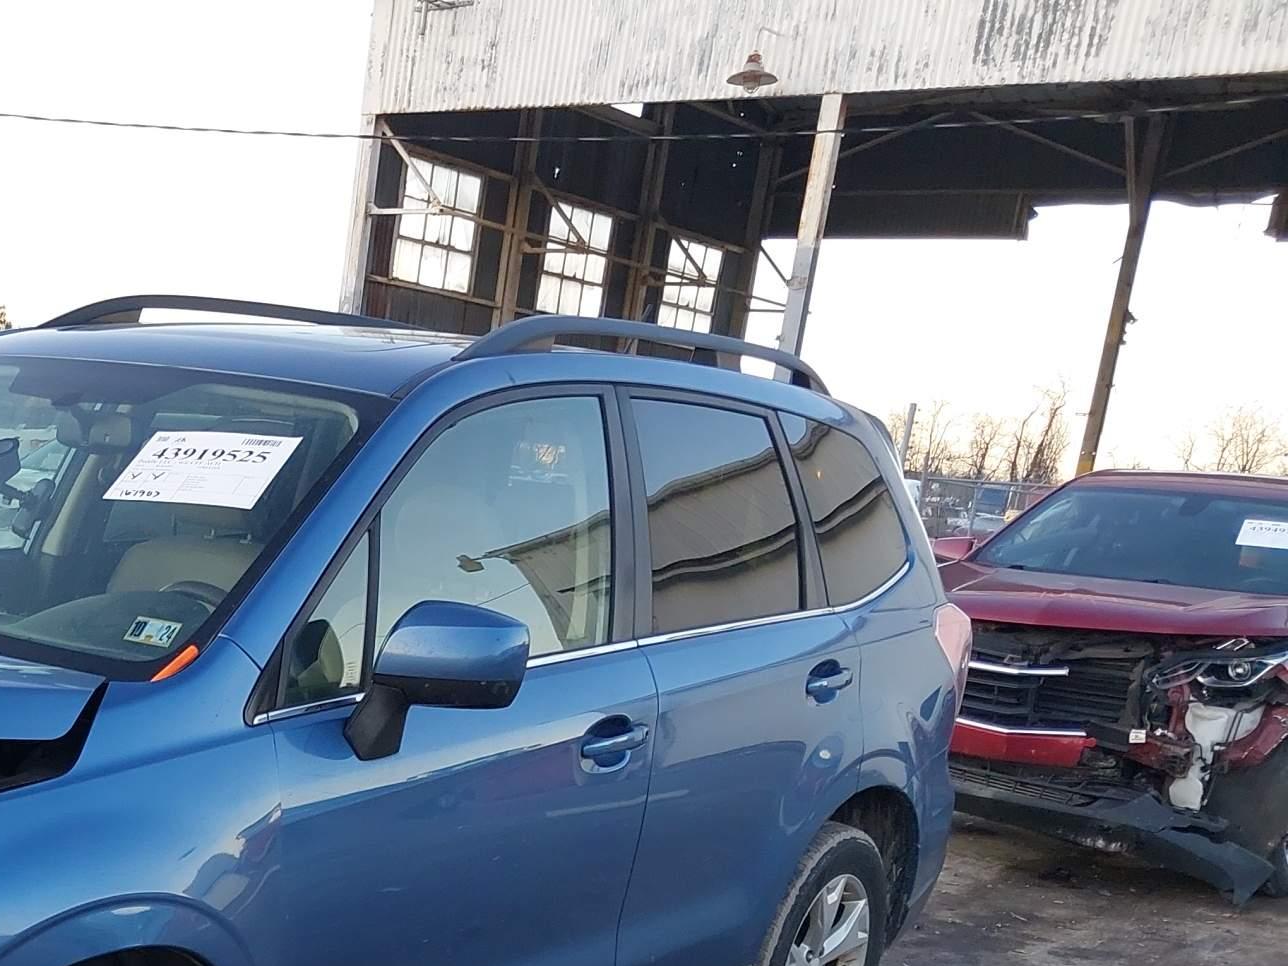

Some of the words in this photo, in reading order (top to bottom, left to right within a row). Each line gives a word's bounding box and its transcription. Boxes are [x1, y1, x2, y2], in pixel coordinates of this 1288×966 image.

[151, 446, 272, 465] 43919525
[130, 620, 148, 637] 10
[159, 625, 177, 642] 24
